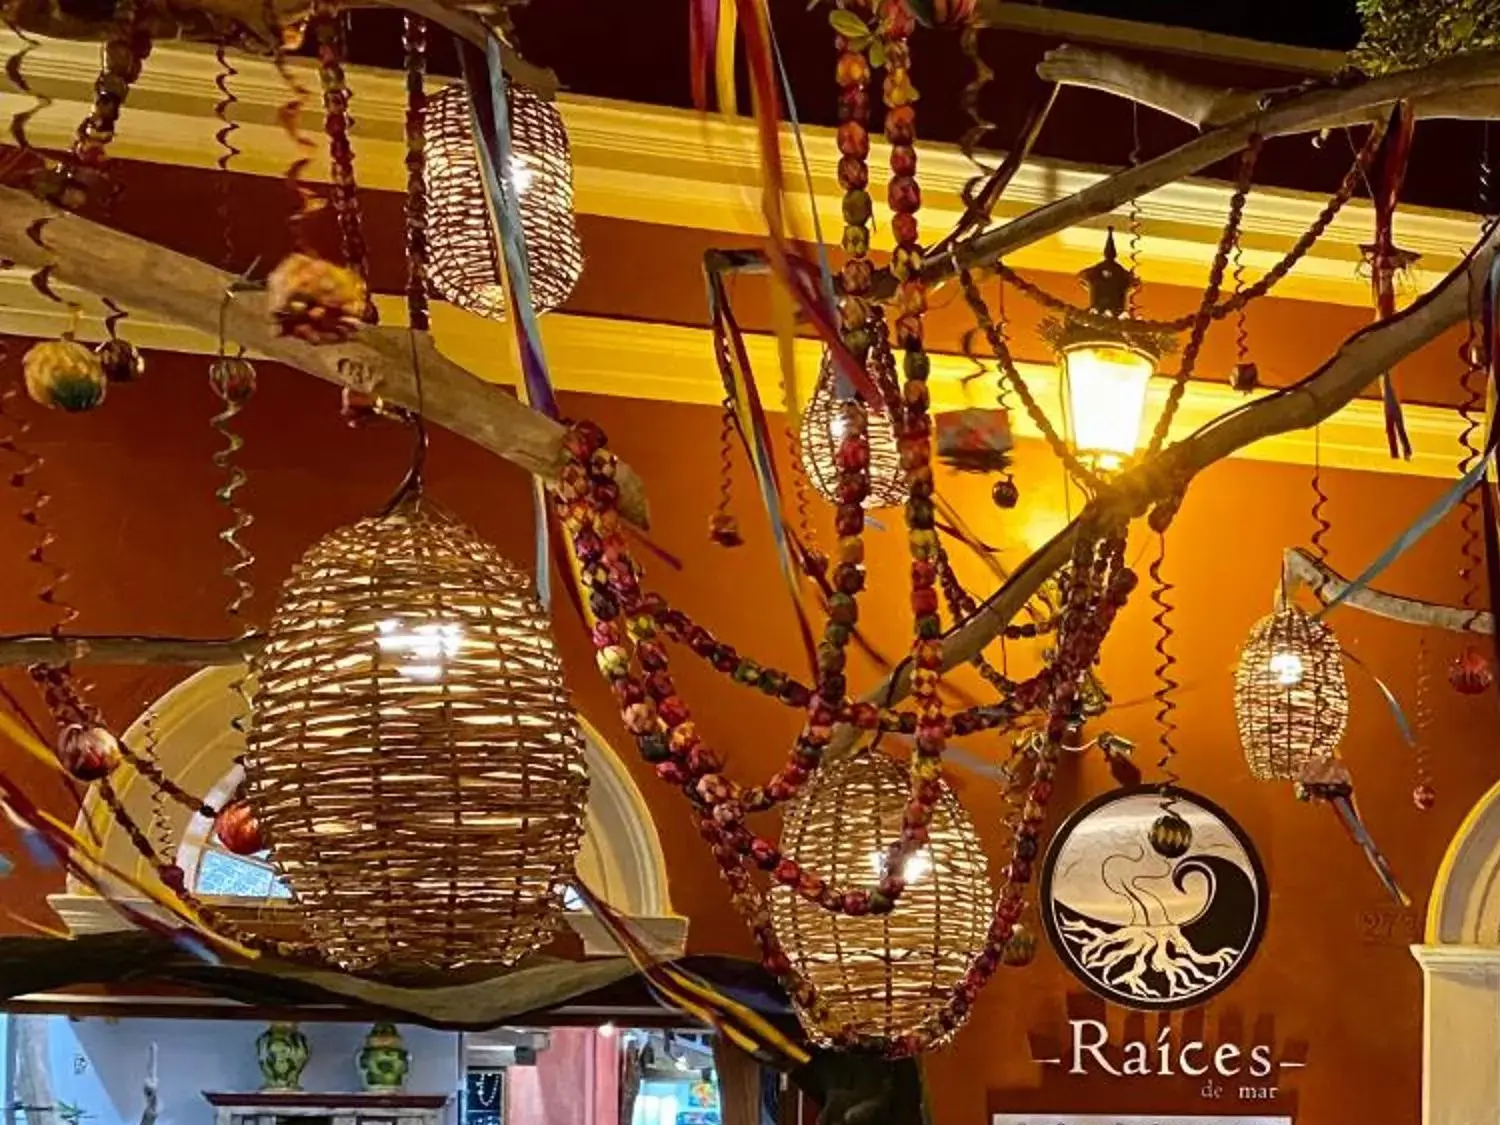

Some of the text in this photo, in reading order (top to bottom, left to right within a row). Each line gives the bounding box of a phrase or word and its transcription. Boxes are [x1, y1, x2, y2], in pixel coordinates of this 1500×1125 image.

[1069, 1019, 1272, 1076] Raíces
[1201, 1080, 1279, 1100] de mar
